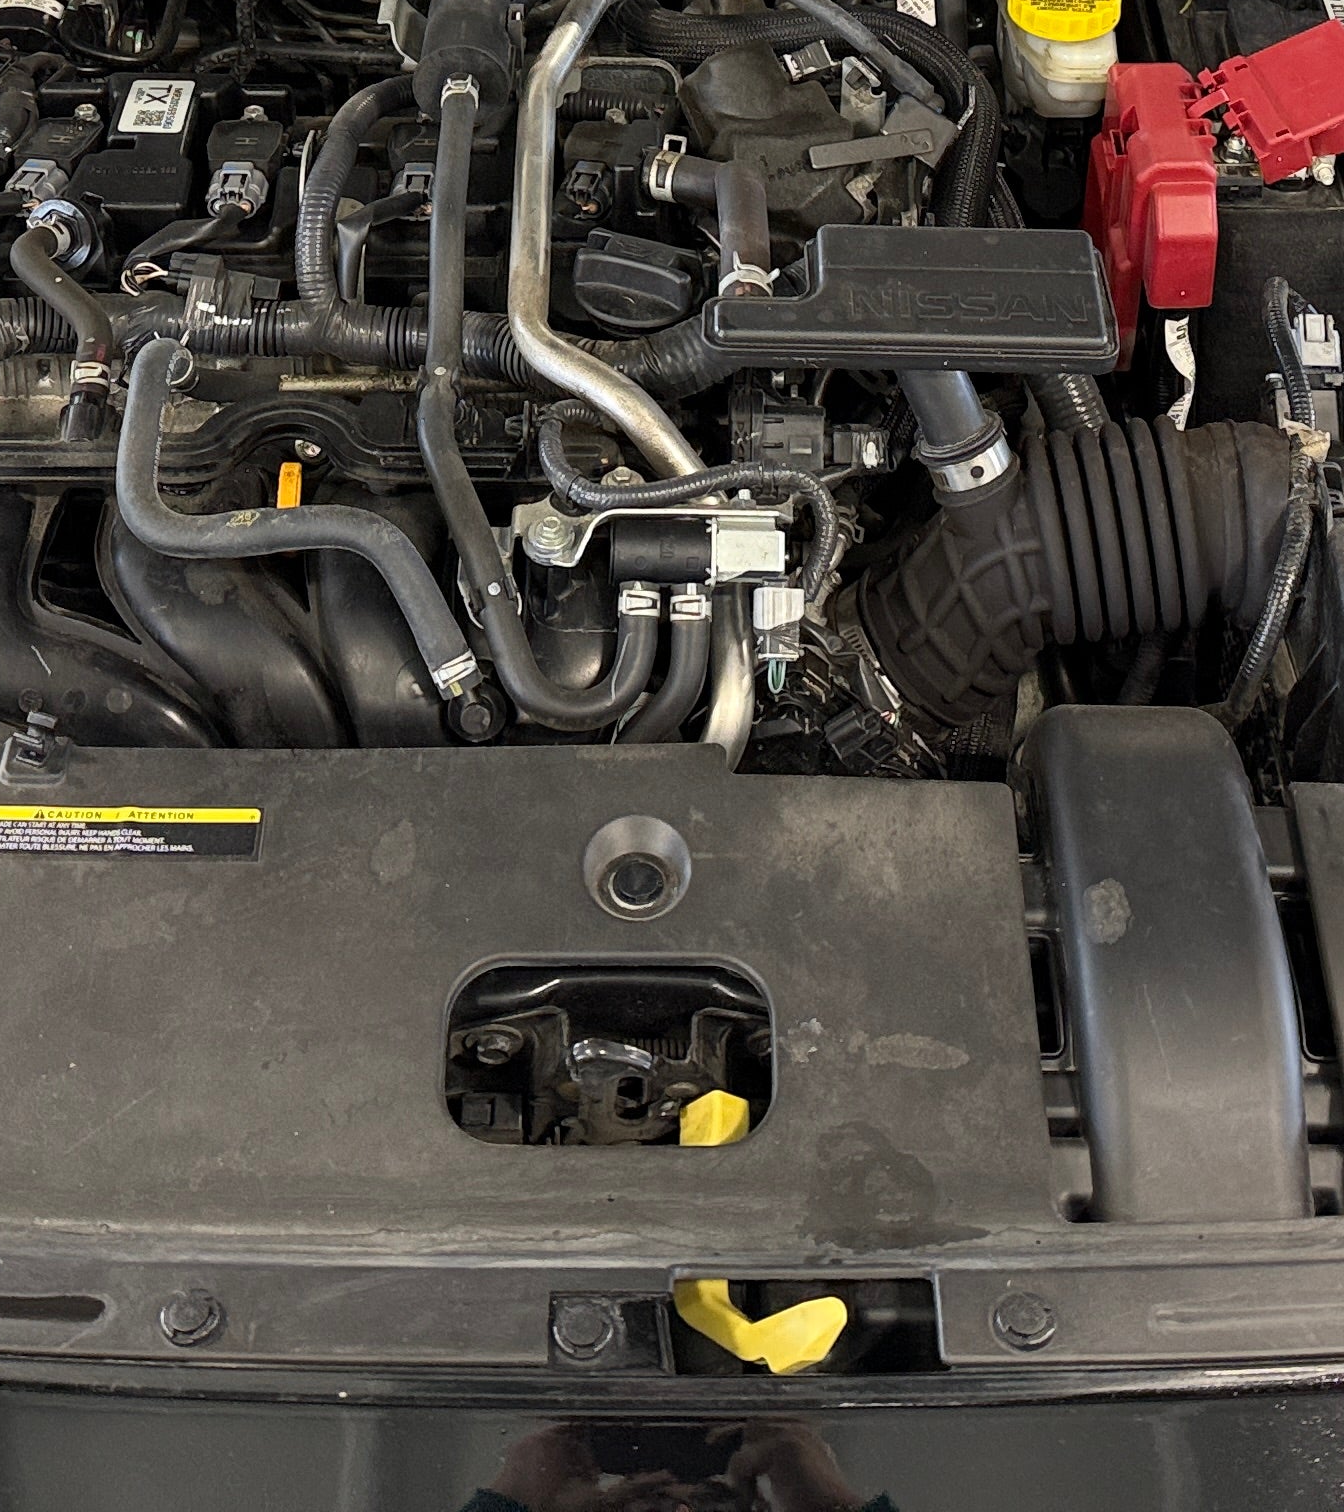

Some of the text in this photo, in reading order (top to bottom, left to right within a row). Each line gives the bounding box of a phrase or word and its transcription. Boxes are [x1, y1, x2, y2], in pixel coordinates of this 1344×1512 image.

[143, 83, 173, 105] TX
[848, 285, 1089, 323] NISSAN
[47, 810, 102, 819] CAUTION
[128, 811, 194, 820] ATTENTION
